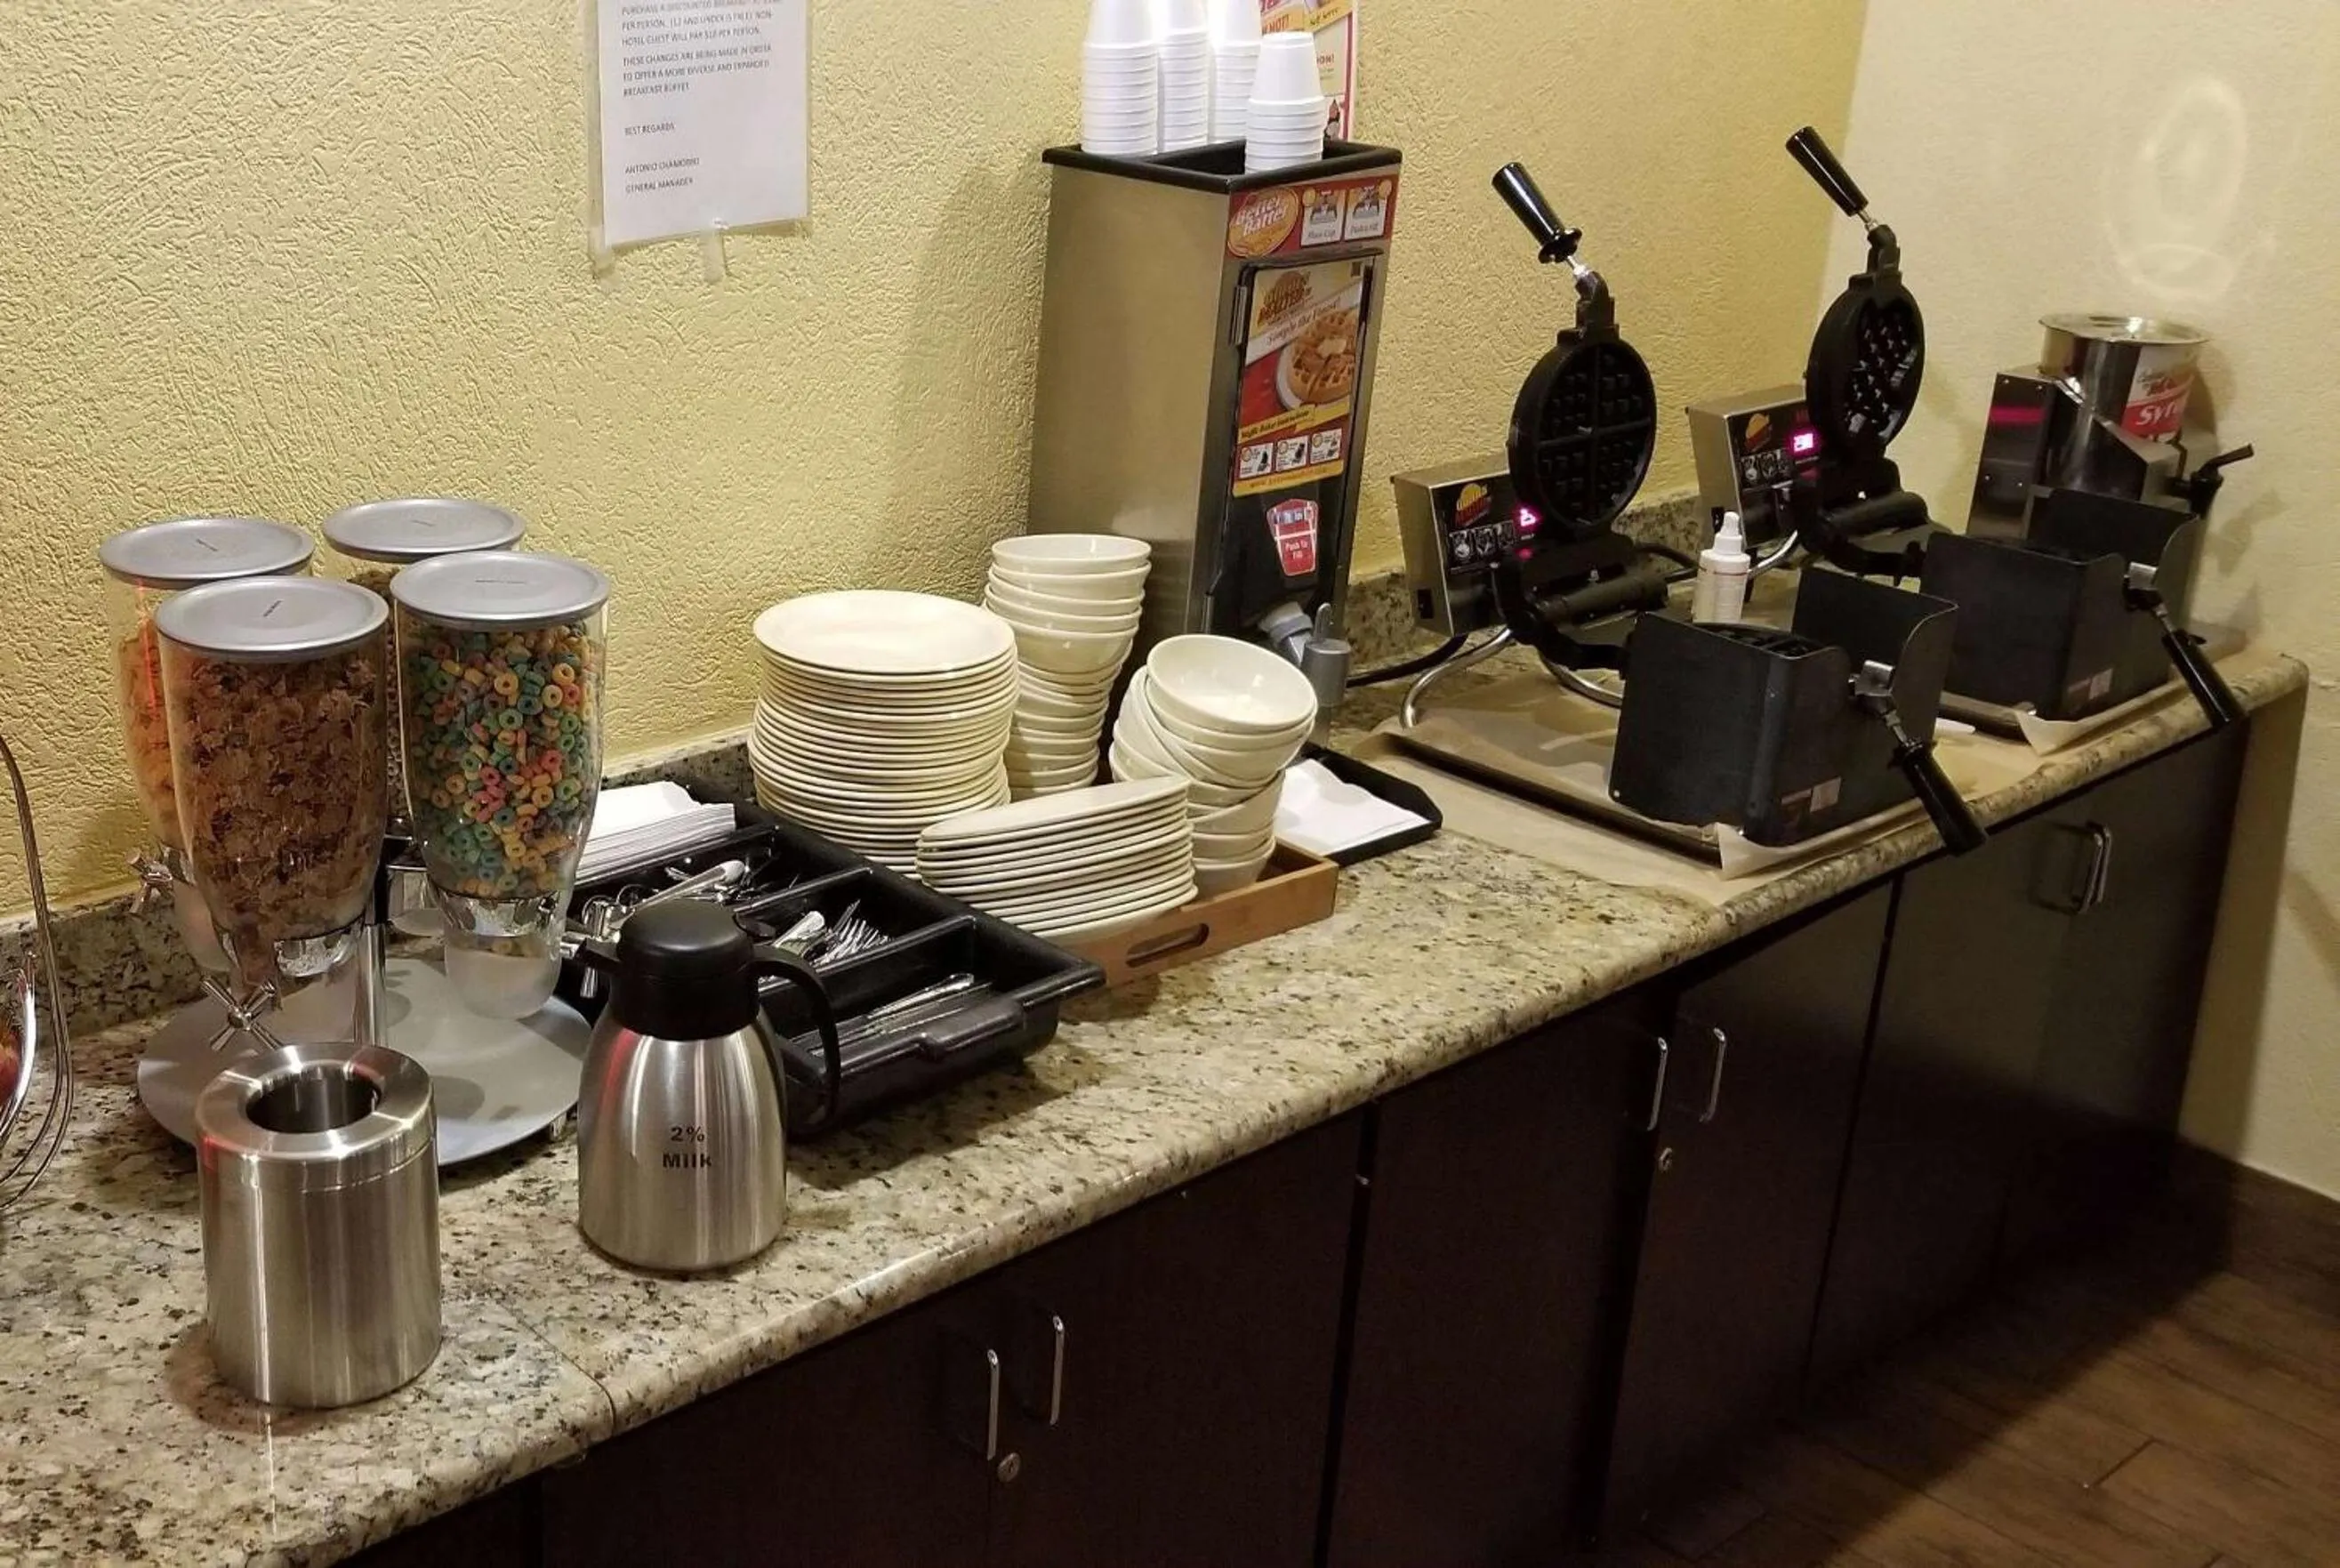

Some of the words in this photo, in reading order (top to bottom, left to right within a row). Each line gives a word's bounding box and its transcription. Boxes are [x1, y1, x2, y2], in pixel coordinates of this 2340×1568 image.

[623, 21, 637, 31] PER
[623, 36, 646, 46] HOTEL
[647, 34, 670, 44] GUEST
[671, 32, 688, 43] WILL
[623, 55, 644, 67] THESE
[646, 53, 679, 65] CHANGES
[680, 52, 694, 61] ARE
[695, 49, 717, 60] BEING
[719, 47, 738, 58] MADE
[741, 45, 748, 55] IN
[749, 44, 772, 54] ORDER
[623, 71, 632, 82] TO
[634, 69, 657, 81] OFFER
[664, 67, 686, 78] MORE
[688, 65, 715, 76] DIVERSE
[717, 63, 732, 74] AND
[733, 60, 770, 71] EXPANDED
[623, 84, 663, 97] BREAKFAST
[663, 82, 690, 94] BUFFET
[624, 125, 641, 136] BEST
[642, 122, 675, 133] REGARDS
[624, 163, 658, 174] ANTONIO
[625, 181, 656, 194] GENERAL
[658, 177, 693, 189] MANAGER
[670, 1125, 706, 1143] 2%
